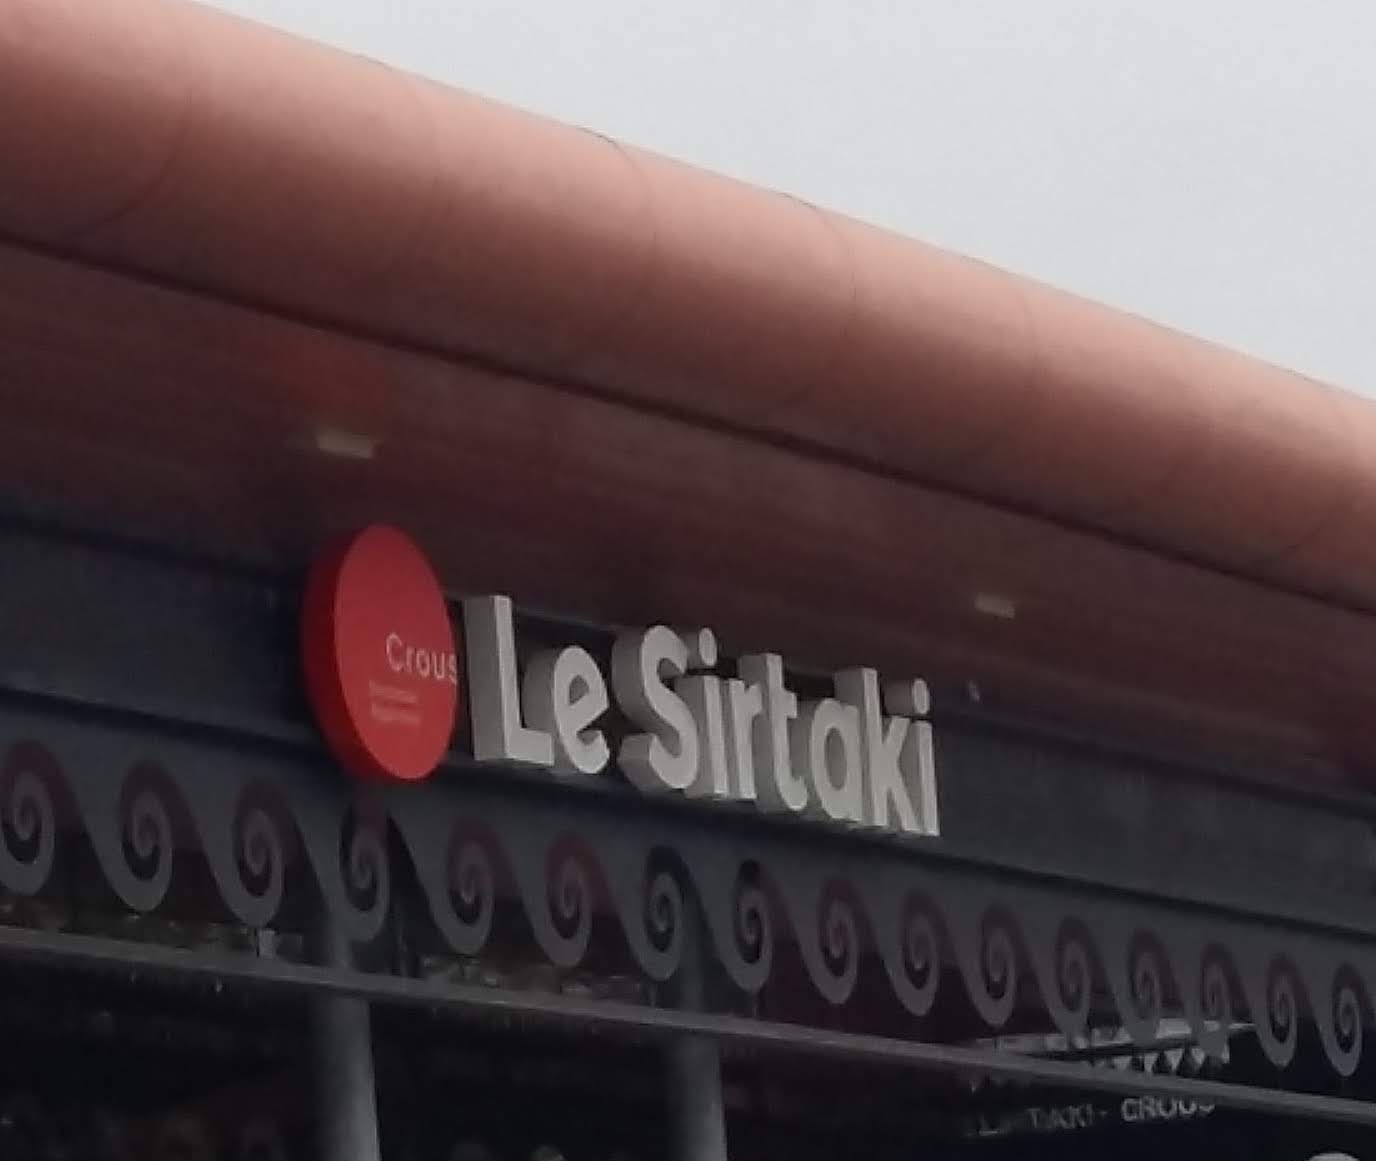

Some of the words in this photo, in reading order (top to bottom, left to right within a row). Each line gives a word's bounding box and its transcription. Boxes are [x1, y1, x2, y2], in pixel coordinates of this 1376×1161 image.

[384, 631, 458, 684] Crous
[465, 595, 611, 774] Le
[612, 624, 940, 837] Sirtaki
